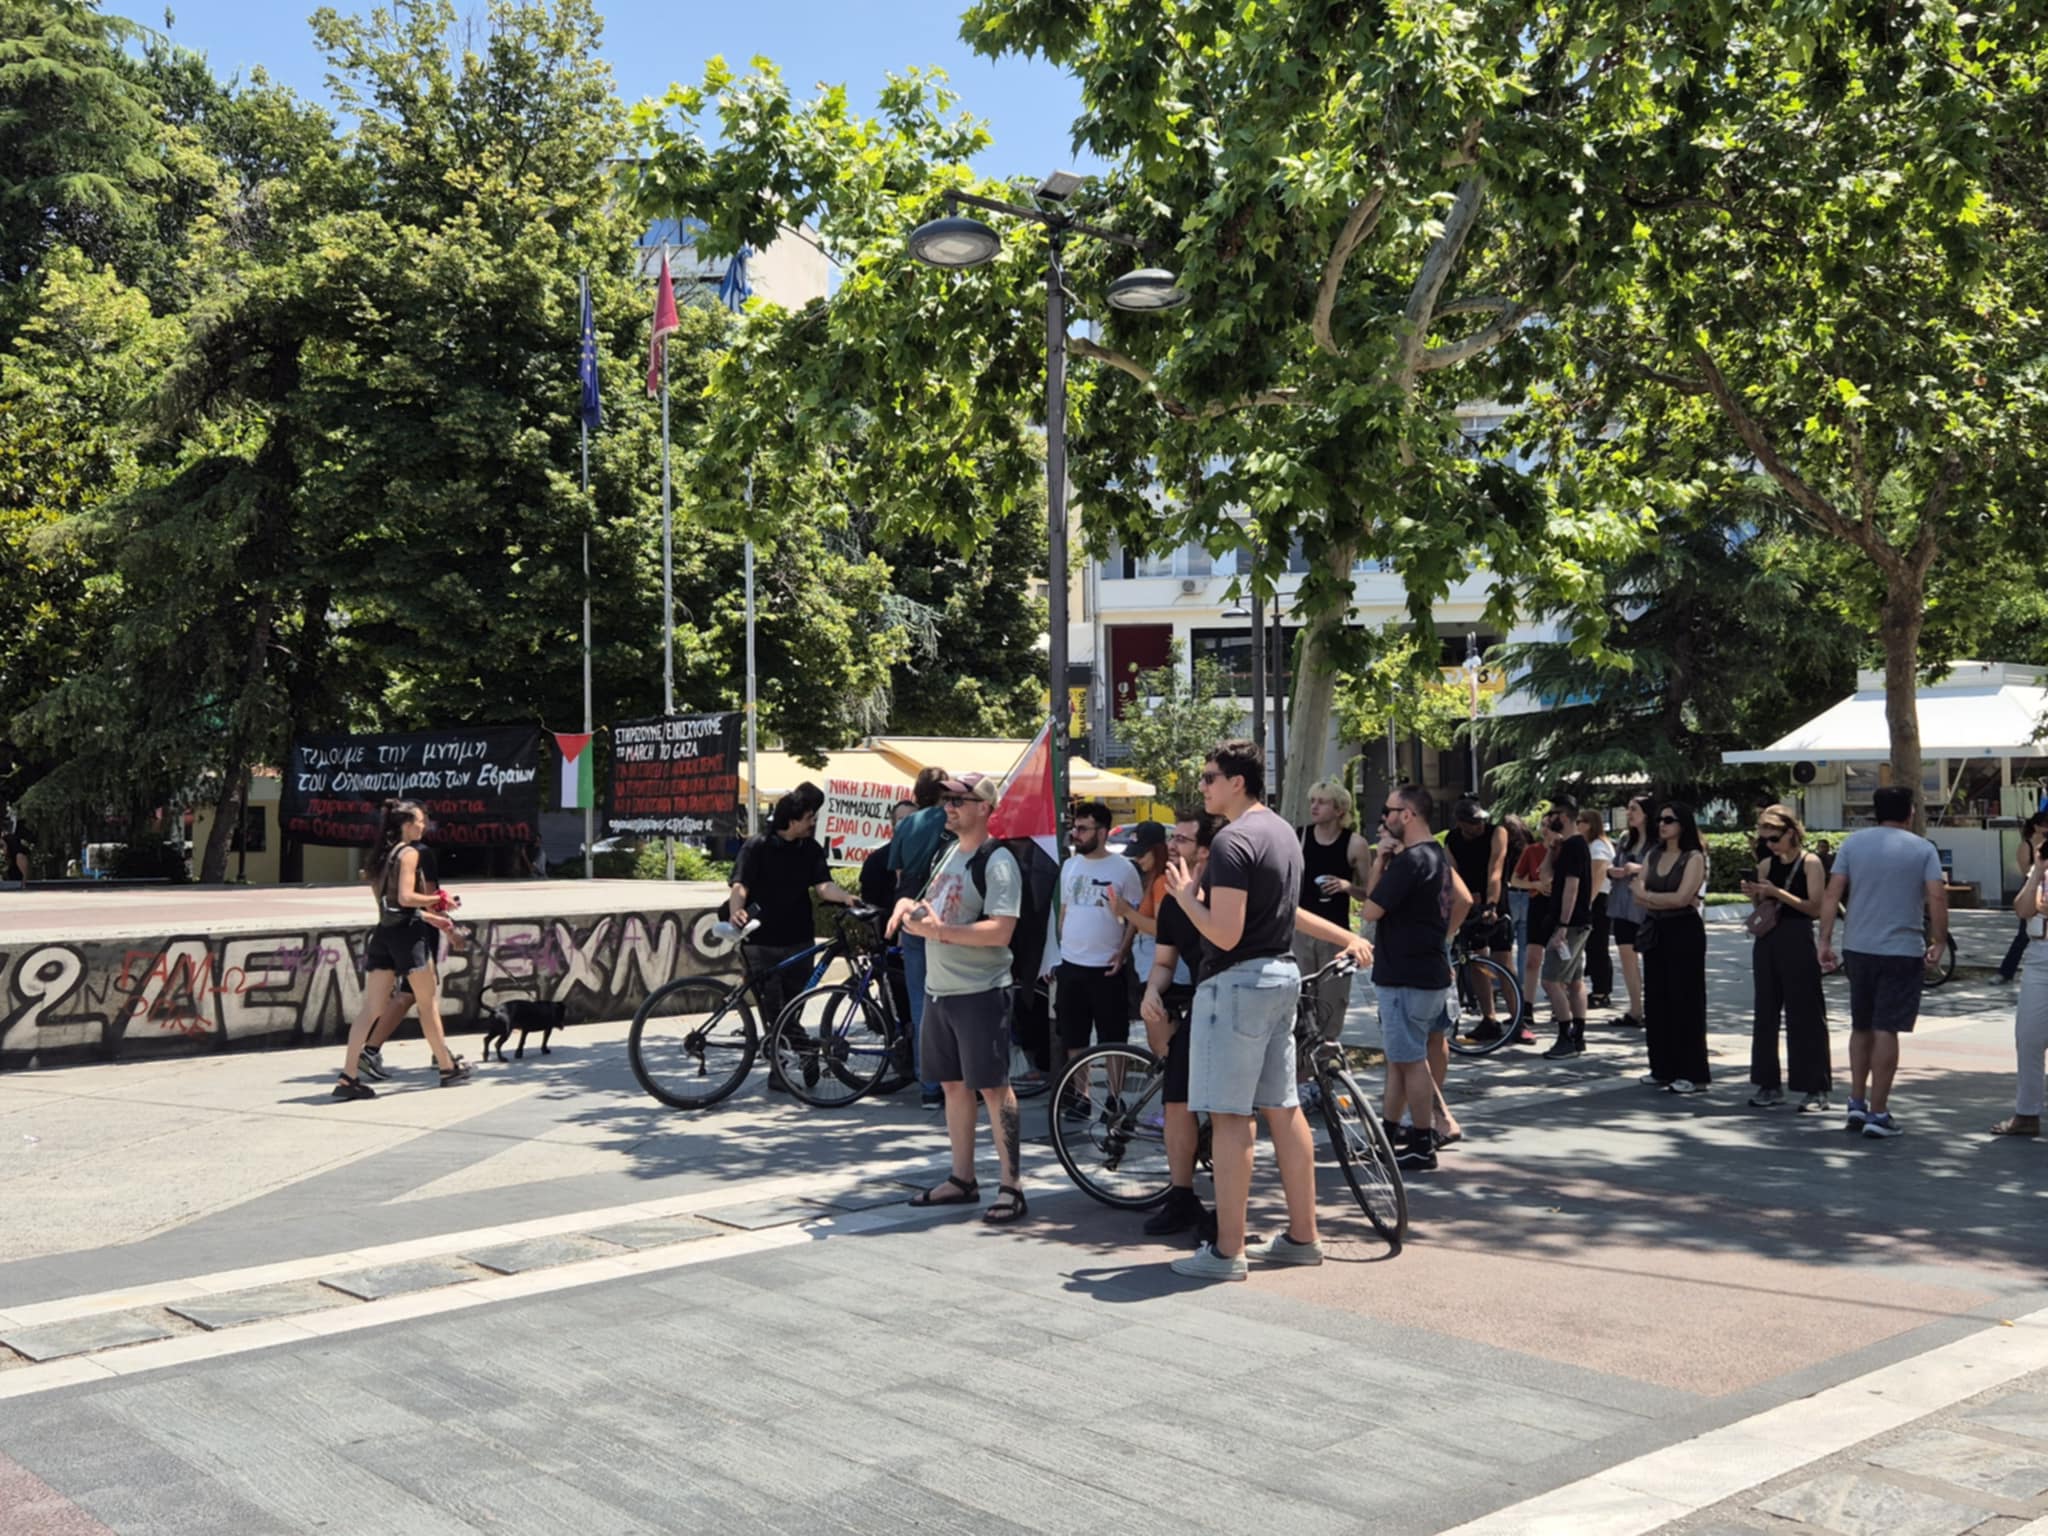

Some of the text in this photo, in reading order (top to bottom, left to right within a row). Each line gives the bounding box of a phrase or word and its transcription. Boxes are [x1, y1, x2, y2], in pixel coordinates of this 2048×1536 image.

[377, 744, 412, 764] την
[422, 737, 488, 767] μνήμη
[673, 741, 699, 760] GAZA
[297, 772, 327, 792] του
[829, 779, 913, 801] ΝΙΚΗ ΣΤΗΝ ΠΑ
[828, 798, 883, 819] ΣΥΜΜΑΧΟΣ
[826, 816, 859, 834] ΕΙΝΑΙ
[862, 821, 871, 837] Ο
